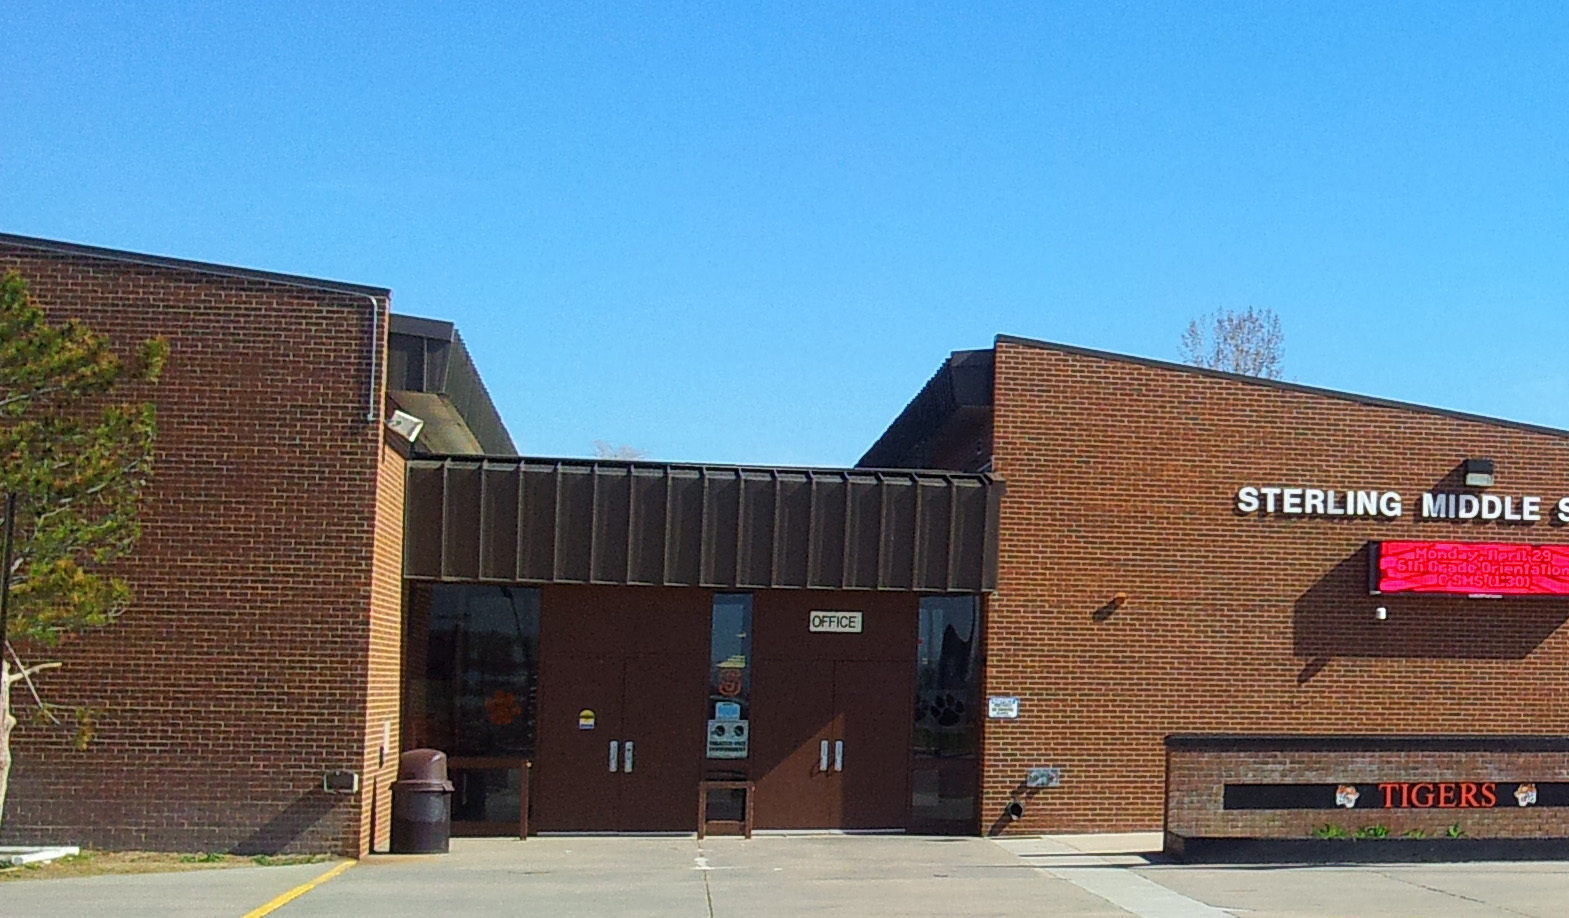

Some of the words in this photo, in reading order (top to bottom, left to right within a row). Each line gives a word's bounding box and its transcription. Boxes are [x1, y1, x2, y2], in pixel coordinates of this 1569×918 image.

[1237, 486, 1402, 517] STERLING
[1421, 491, 1542, 521] MIDDLE
[1488, 549, 1528, 562] April
[1532, 550, 1552, 561] 29
[1397, 559, 1424, 572] 6th
[1428, 560, 1478, 574] Grade
[812, 614, 857, 629] OFFICE
[1378, 782, 1497, 808] TIGERS
